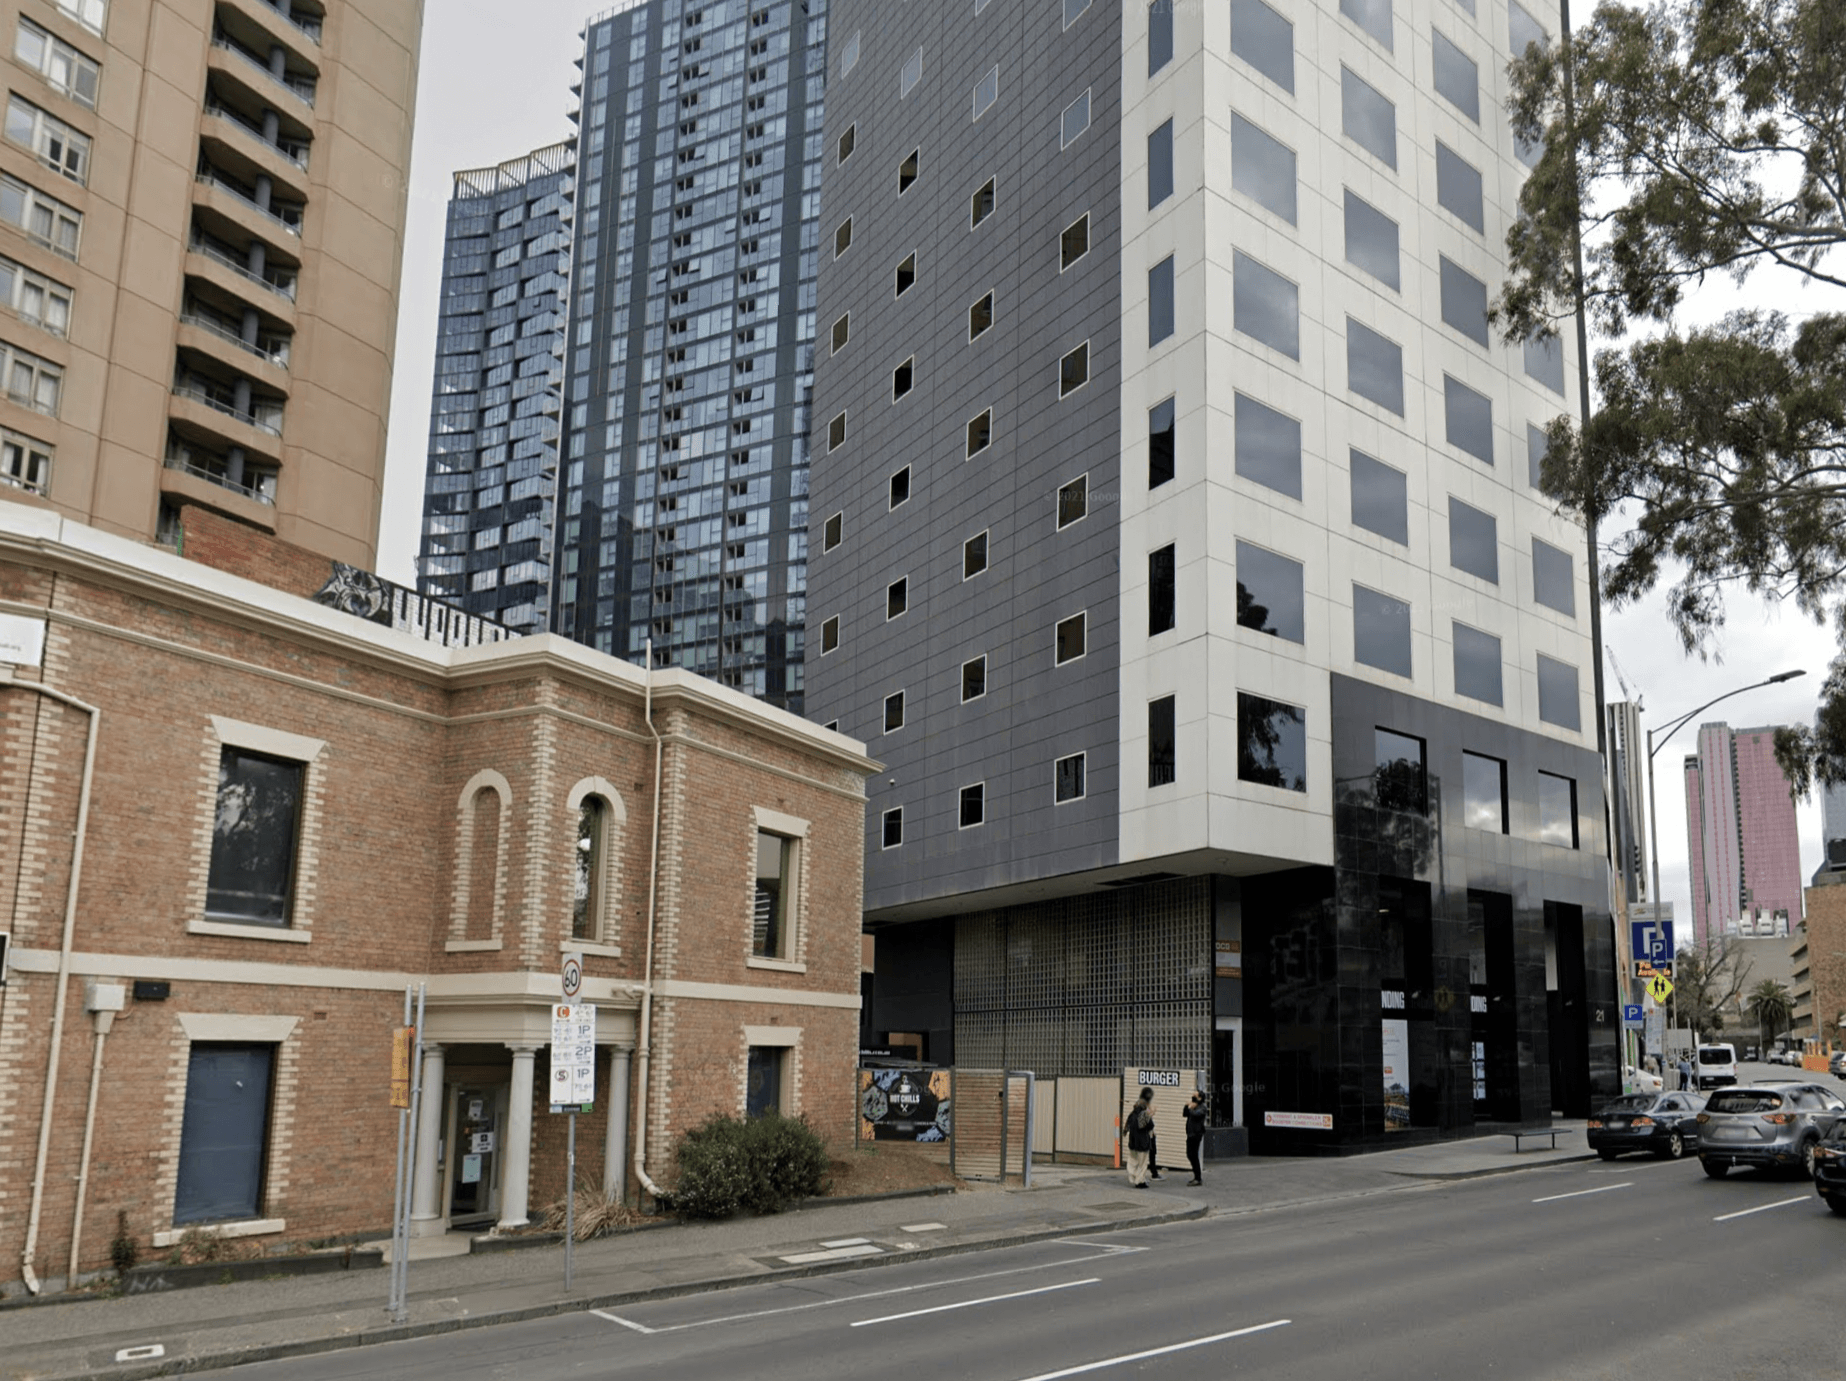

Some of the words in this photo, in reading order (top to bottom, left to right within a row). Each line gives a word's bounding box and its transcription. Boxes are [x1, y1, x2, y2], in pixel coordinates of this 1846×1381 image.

[1652, 942, 1664, 958] P
[565, 969, 578, 988] 60
[1595, 1009, 1605, 1022] 21
[1628, 1007, 1639, 1019] P
[578, 1025, 591, 1034] 1P
[575, 1046, 592, 1056] 2P
[577, 1068, 590, 1079] 1P
[1139, 1071, 1179, 1086] BURGER
